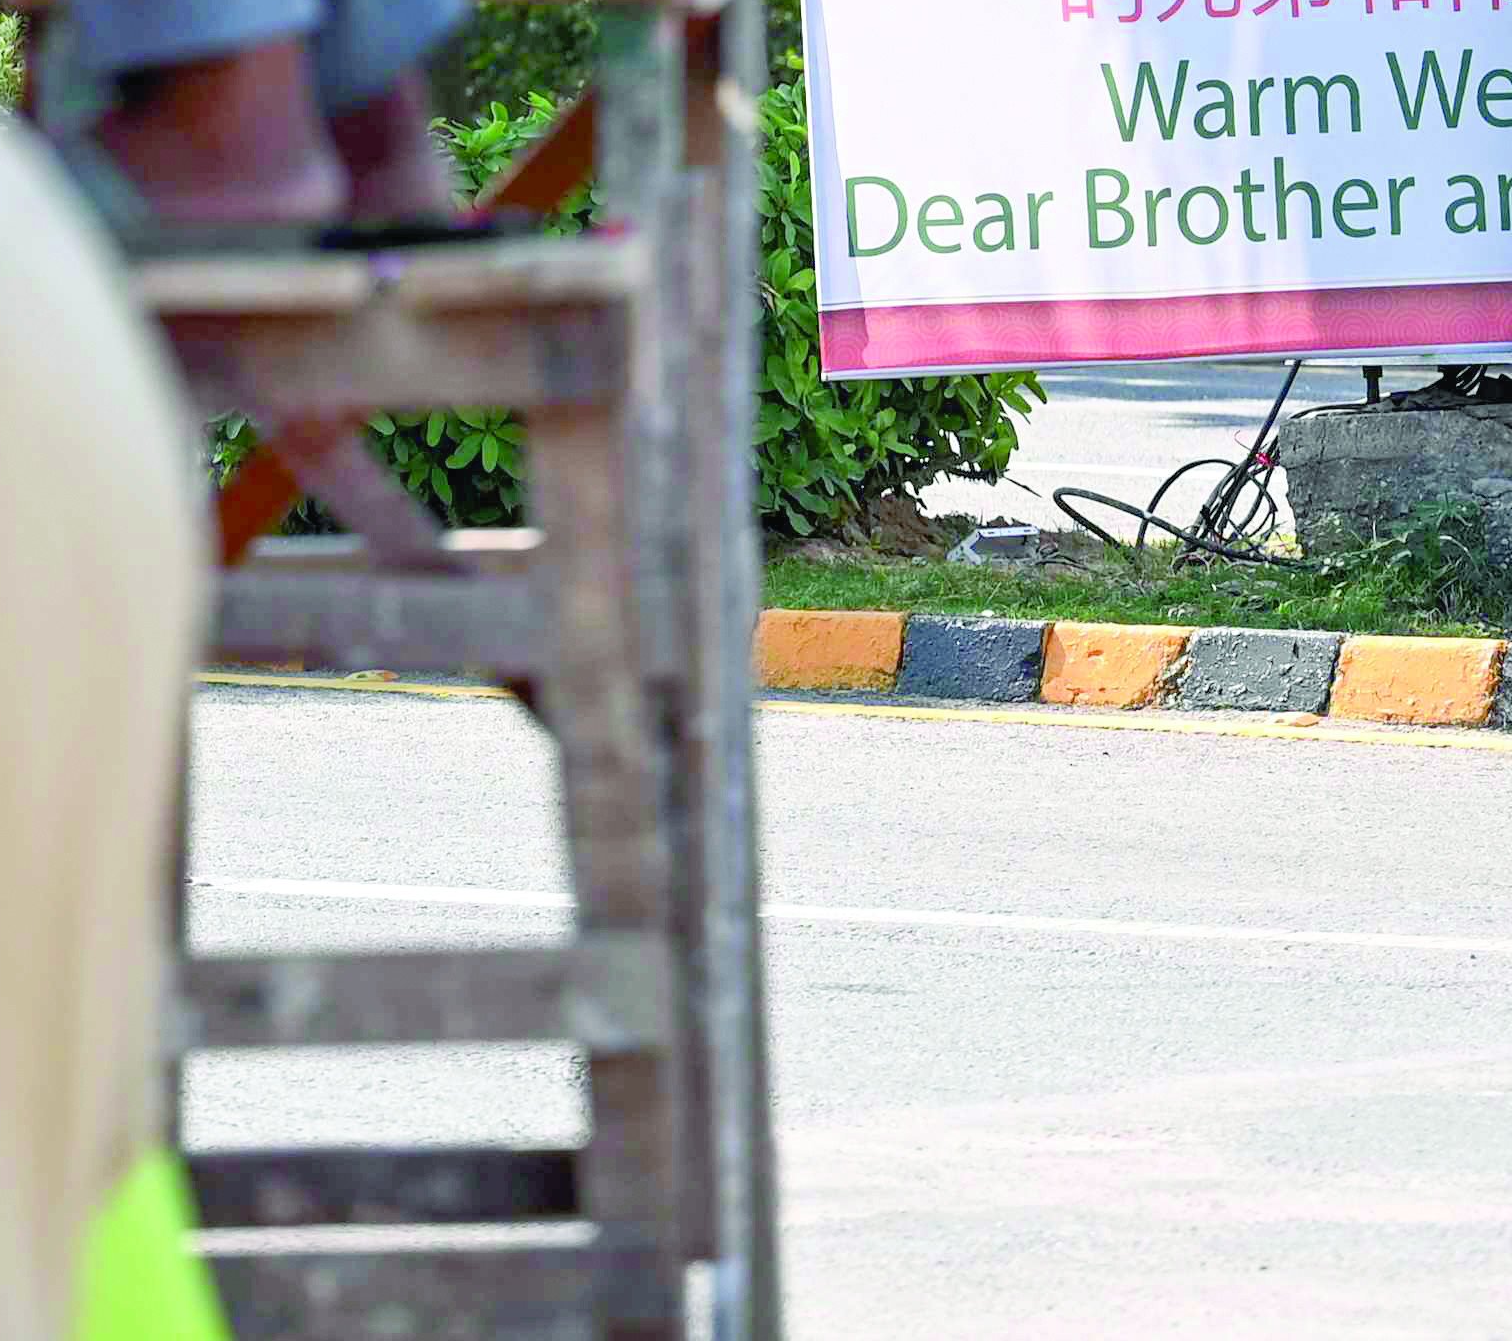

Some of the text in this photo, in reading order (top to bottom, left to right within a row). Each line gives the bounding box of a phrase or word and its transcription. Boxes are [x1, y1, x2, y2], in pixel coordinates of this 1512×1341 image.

[1100, 59, 1362, 143] Warm
[844, 175, 1054, 259] Dear
[1085, 156, 1416, 251] Brother
